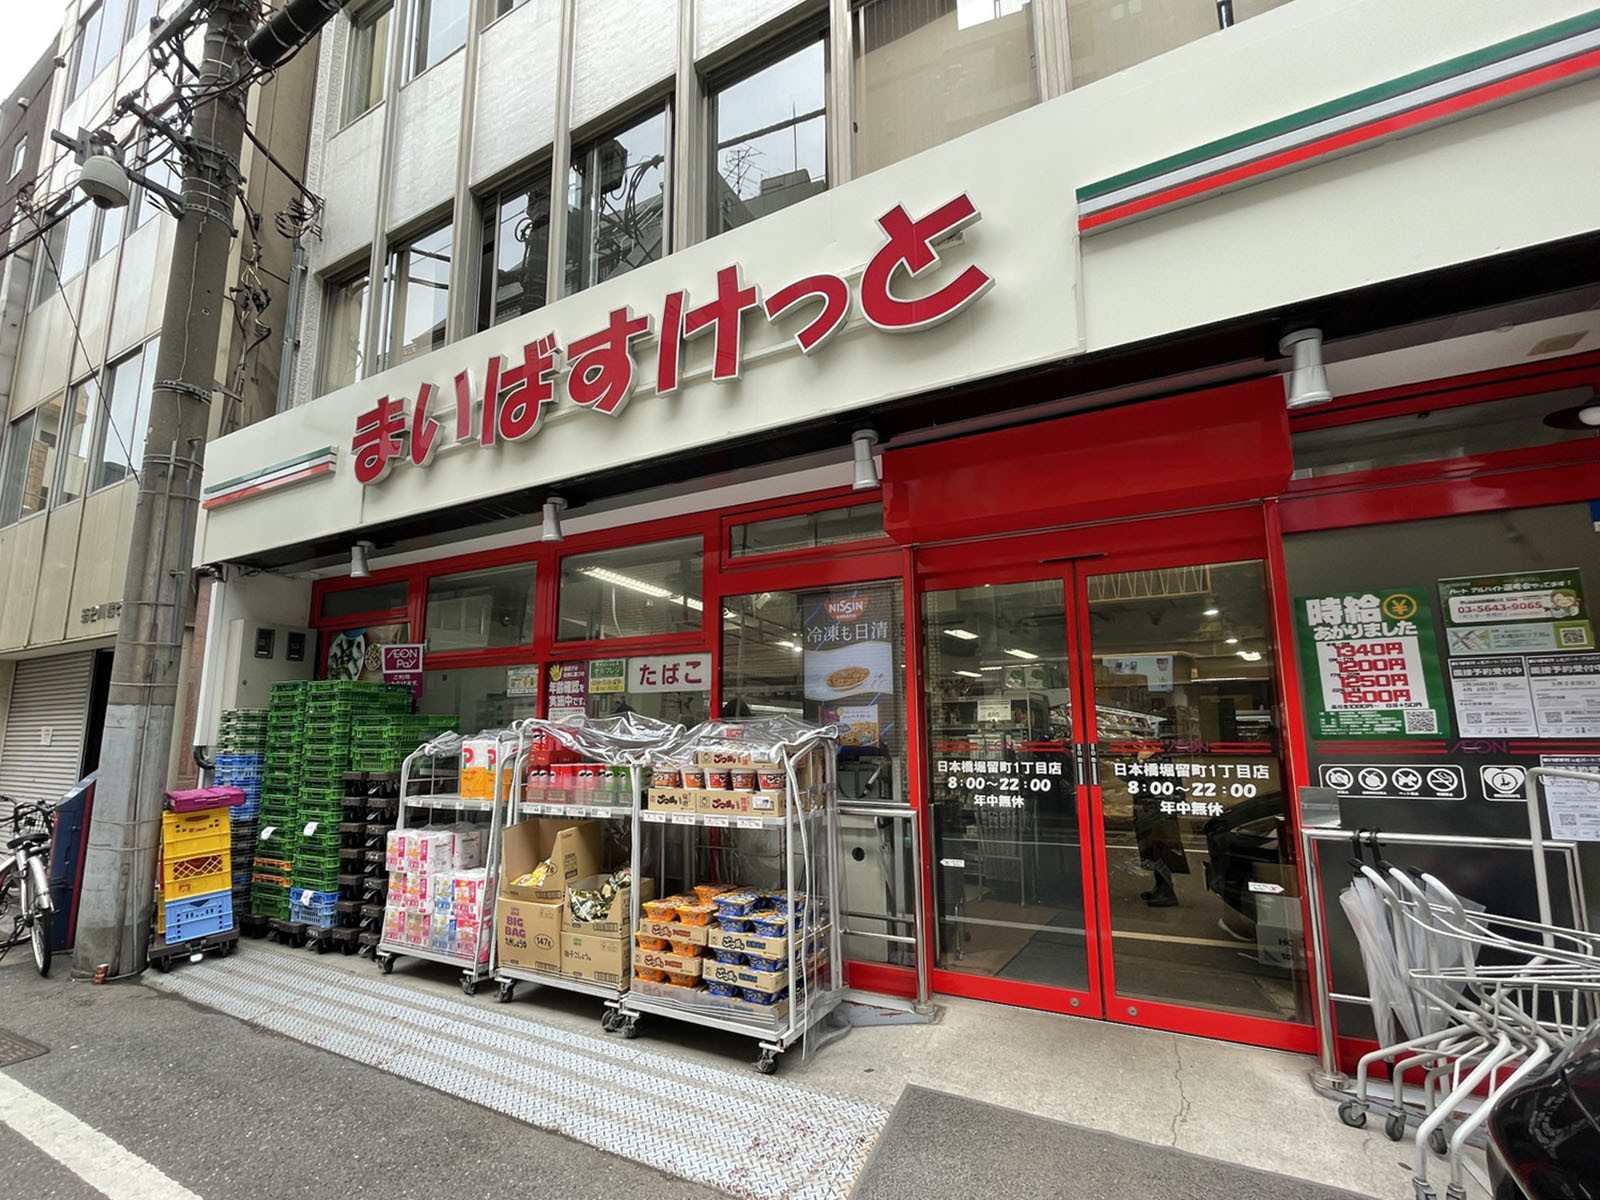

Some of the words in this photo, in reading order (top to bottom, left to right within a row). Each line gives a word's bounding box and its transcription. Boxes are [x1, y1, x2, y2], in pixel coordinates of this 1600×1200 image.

[352, 192, 994, 485] まいばすけっと
[828, 600, 864, 614] NISSIN
[1306, 594, 1382, 626] 時給
[1457, 601, 1543, 614] 03-5643-9065
[806, 621, 889, 644] 冷凍も日清
[1313, 620, 1418, 640] あがりました
[1335, 642, 1404, 657] 1340円
[396, 659, 417, 669] Pay
[1336, 658, 1406, 673] 1200円
[639, 661, 703, 686] たばこ
[1339, 674, 1409, 688] 1250円
[549, 680, 584, 694] 年齢確認を
[1340, 689, 1411, 703] 1500円
[937, 760, 1062, 775] 日本橋堀留町1丁目店
[1113, 762, 1270, 780] 日本橋堀留町1丁目店
[973, 794, 1025, 808] 年中無休
[1160, 801, 1224, 817] 年中無休
[506, 916, 523, 927] BIG
[505, 926, 526, 939] BAG
